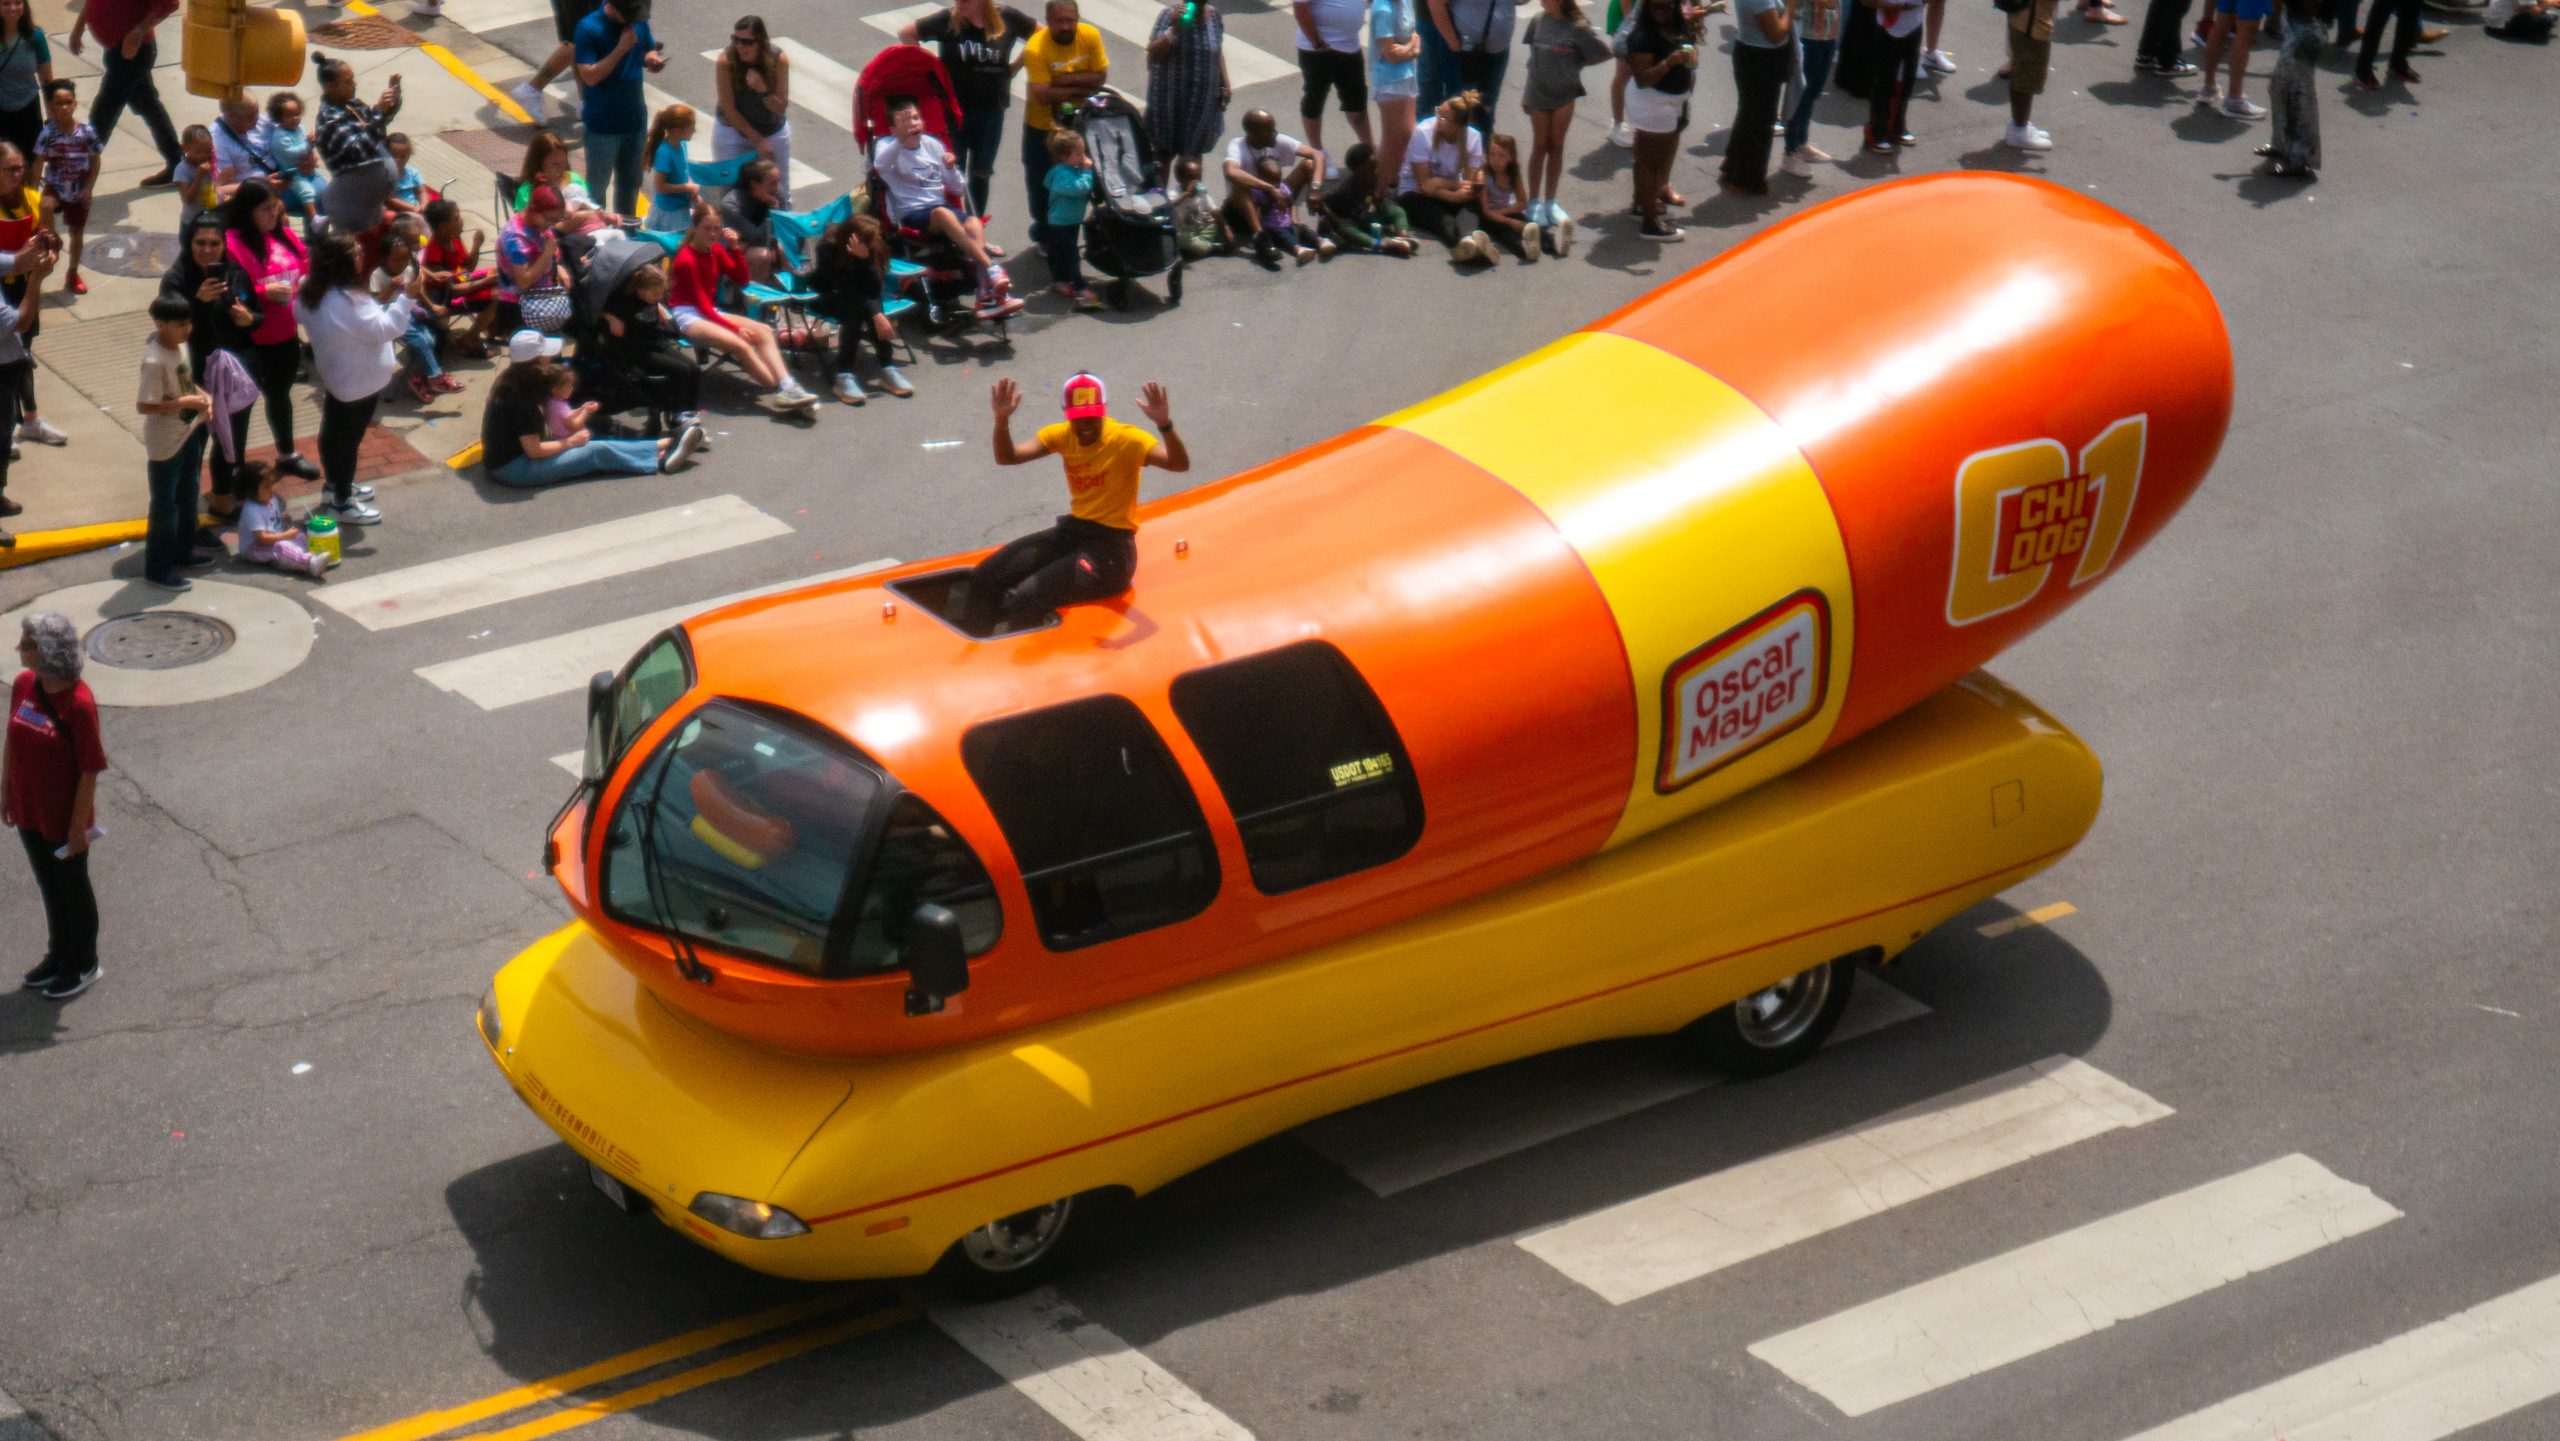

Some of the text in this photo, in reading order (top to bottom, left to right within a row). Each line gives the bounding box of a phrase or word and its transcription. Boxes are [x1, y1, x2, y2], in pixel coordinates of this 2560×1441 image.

[2019, 477, 2087, 530] CHI
[2008, 516, 2089, 571] DOG
[1695, 631, 1802, 718] Oscar
[1688, 667, 1805, 759] Mayer
[1330, 760, 1362, 781] USDOT
[539, 1088, 617, 1158] WIENERMOBILE
